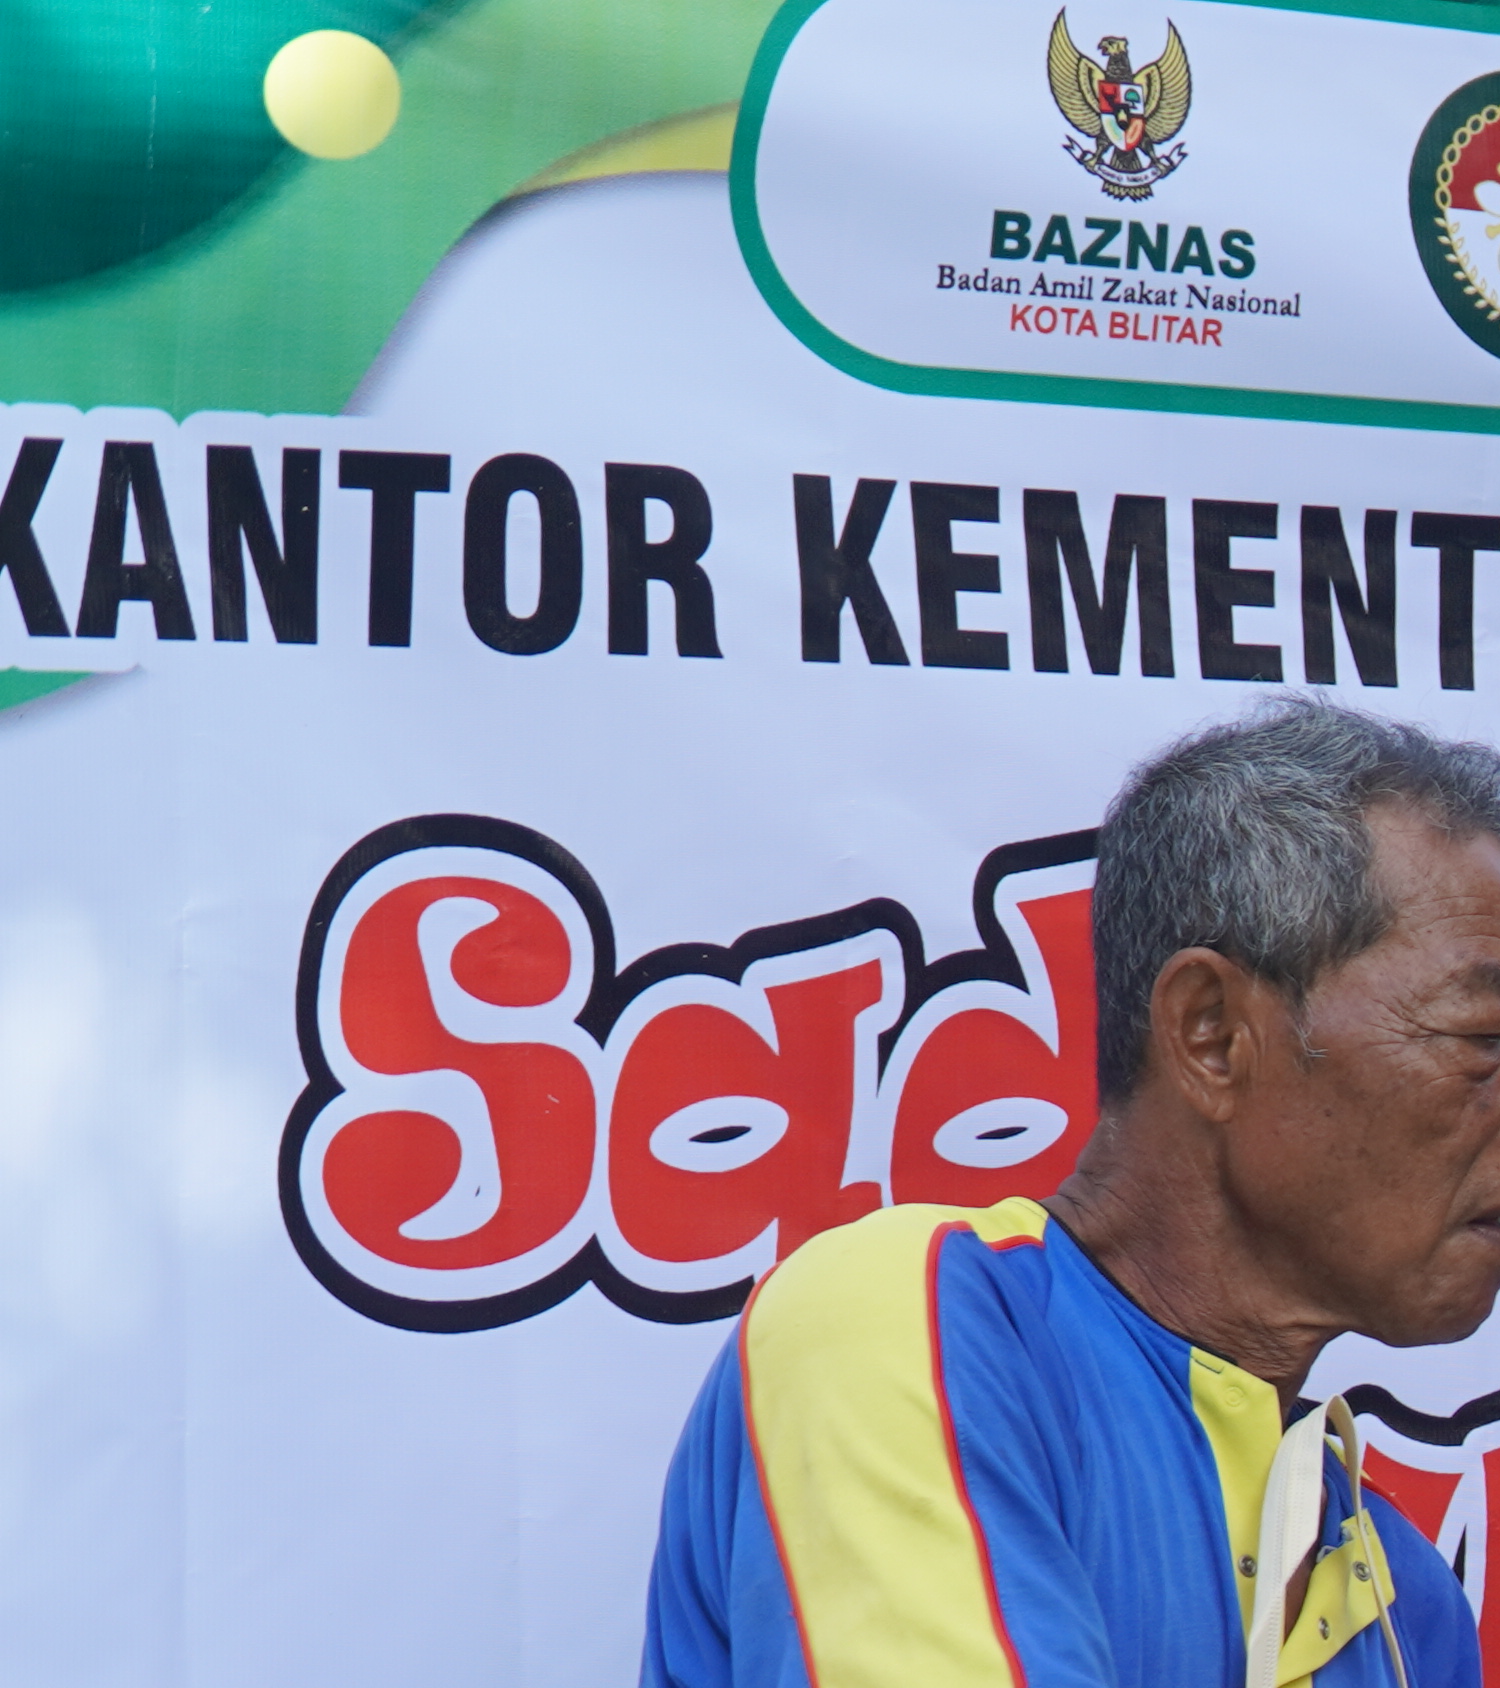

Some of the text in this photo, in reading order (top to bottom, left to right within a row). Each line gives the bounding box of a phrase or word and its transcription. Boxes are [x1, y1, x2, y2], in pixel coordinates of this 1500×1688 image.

[990, 209, 1256, 279] BAZNAS
[936, 264, 1301, 318] Badan Amil Zakat Nasional
[1009, 303, 1223, 347] KOTA BLITAR
[0, 437, 724, 658] KANTOR
